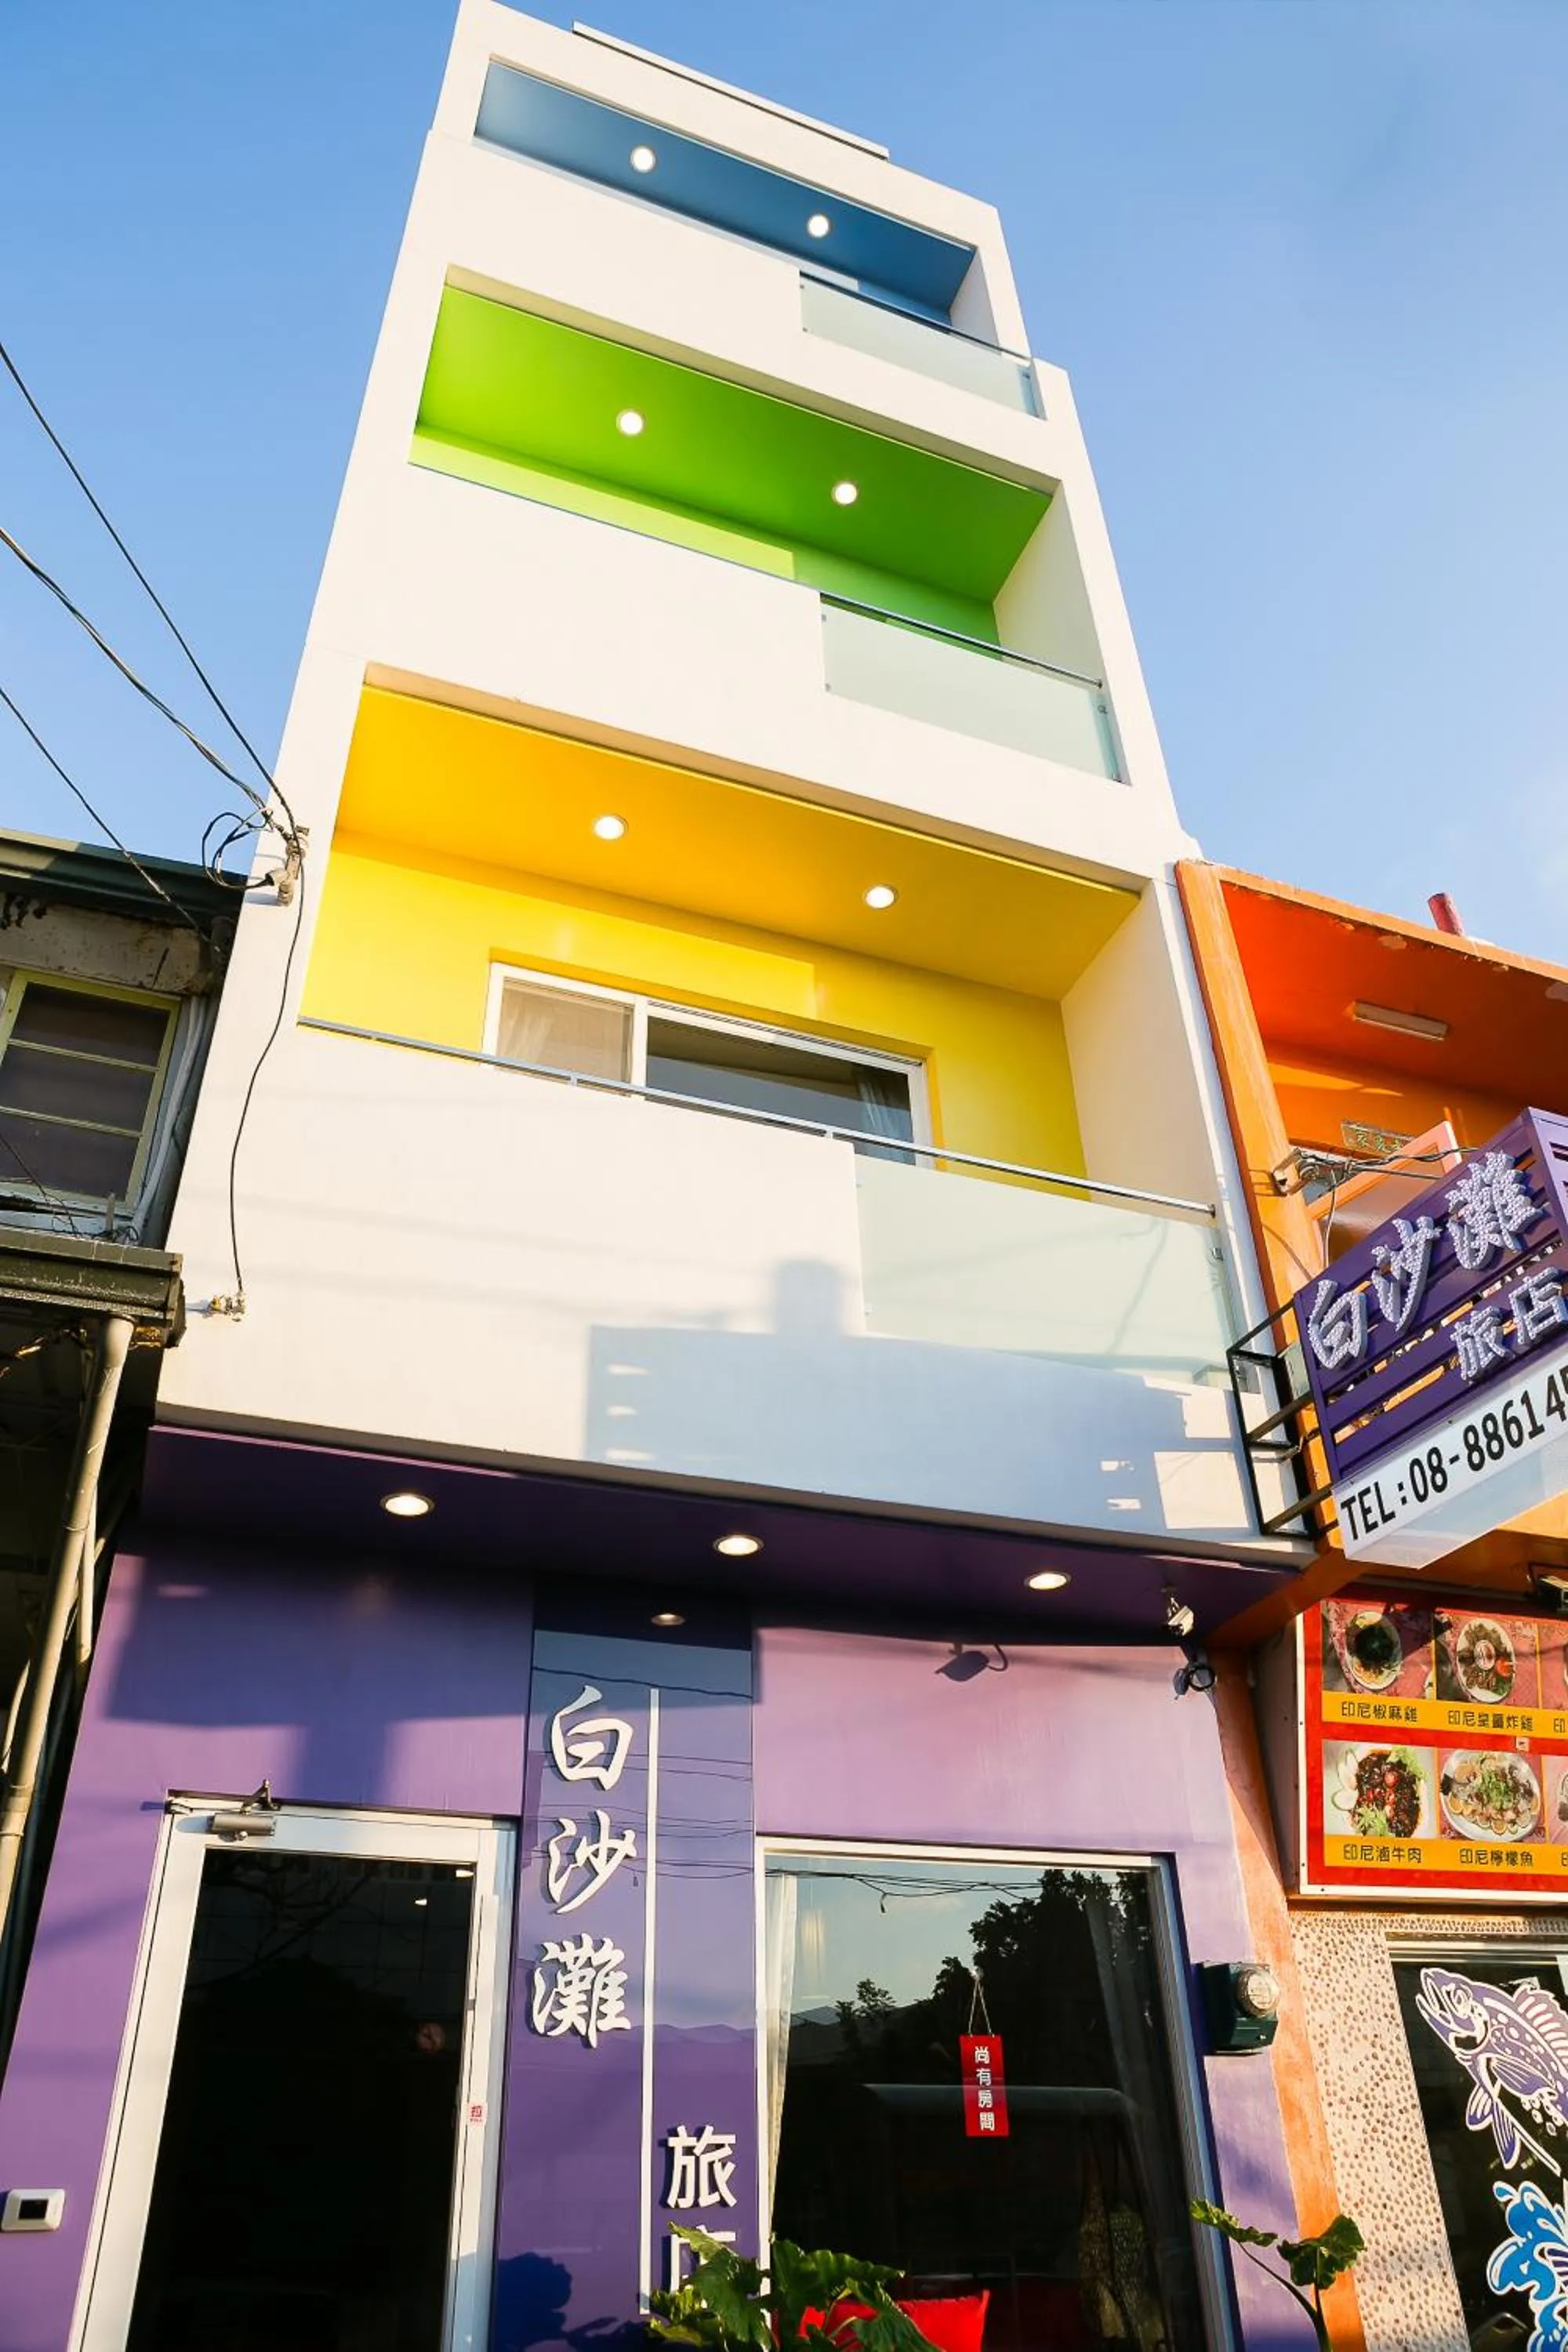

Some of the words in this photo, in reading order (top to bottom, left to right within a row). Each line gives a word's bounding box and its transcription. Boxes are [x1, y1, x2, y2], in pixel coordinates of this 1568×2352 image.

[1308, 1150, 1544, 1370] 白沙灘
[1450, 1266, 1564, 1384] 旅店
[532, 1685, 637, 2049] 白沙灘
[975, 2045, 995, 2132] 尚有房間
